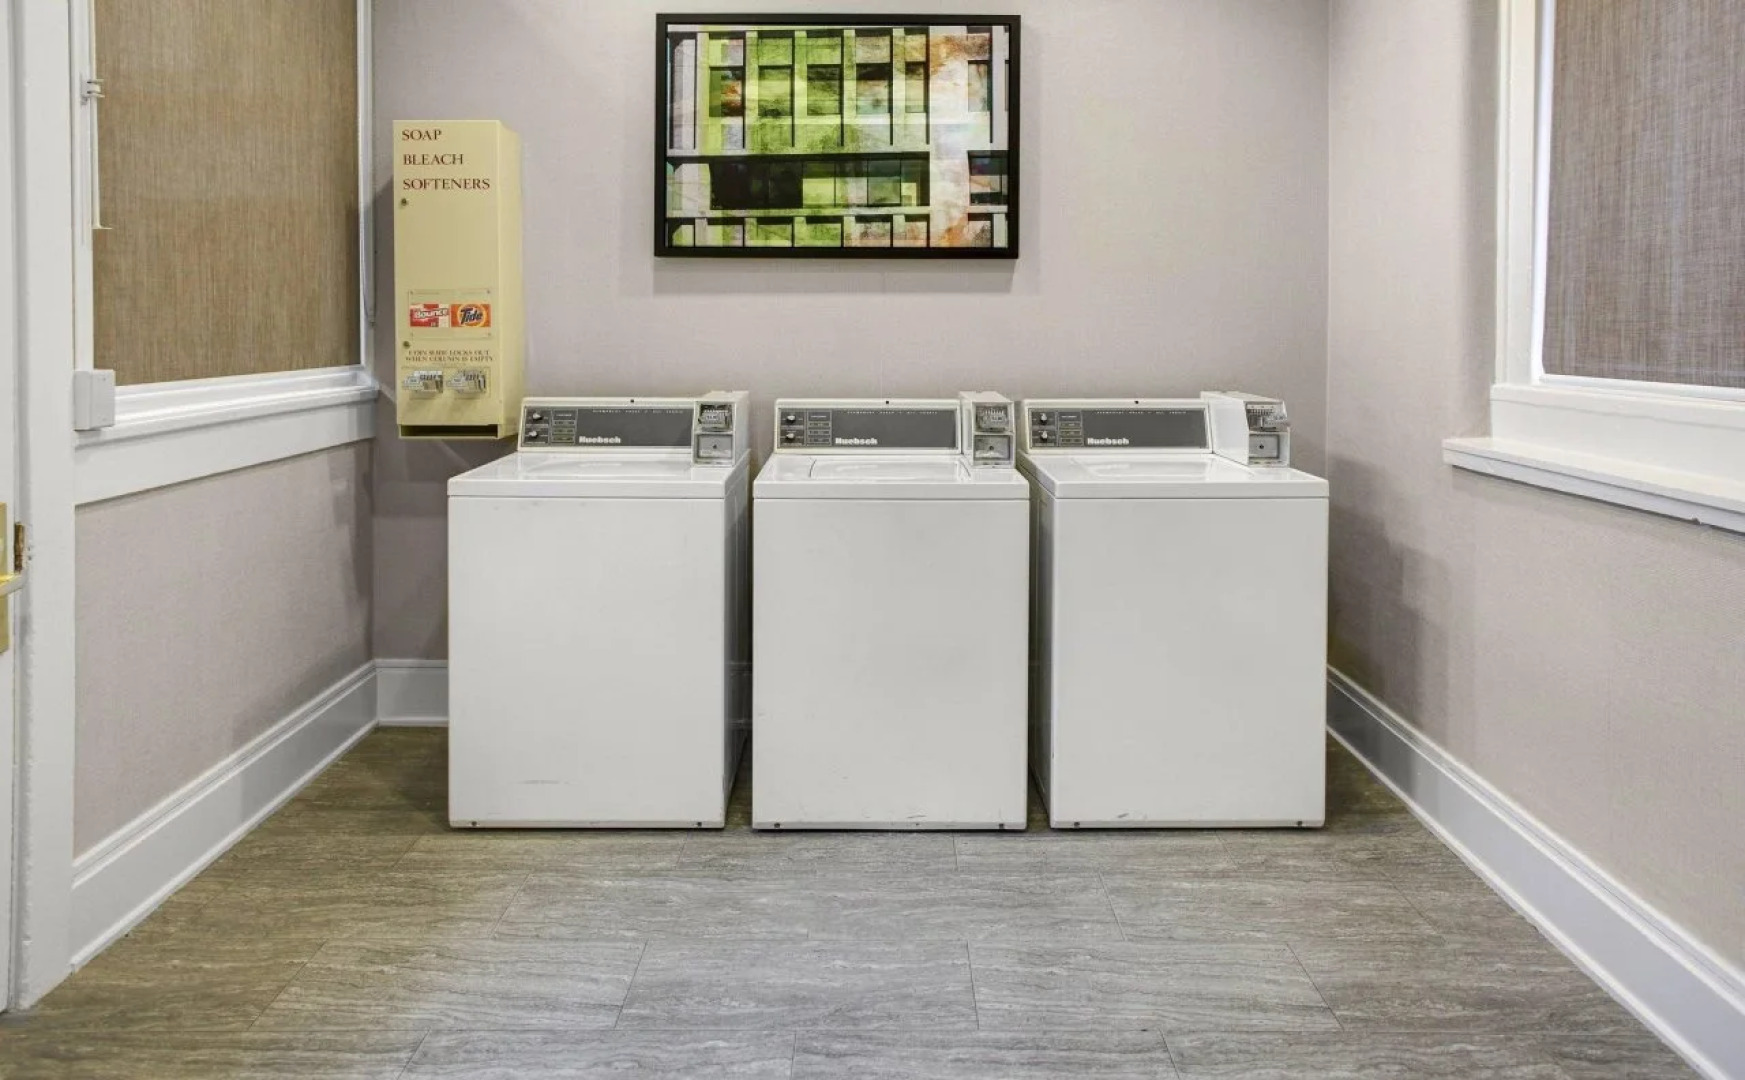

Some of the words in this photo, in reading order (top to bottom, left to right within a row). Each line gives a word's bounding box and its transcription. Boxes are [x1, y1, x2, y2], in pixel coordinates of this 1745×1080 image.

[401, 129, 442, 141] SOAP
[403, 153, 464, 165] BLEACH
[403, 178, 490, 191] SOFTENERS
[460, 307, 483, 325] Tide
